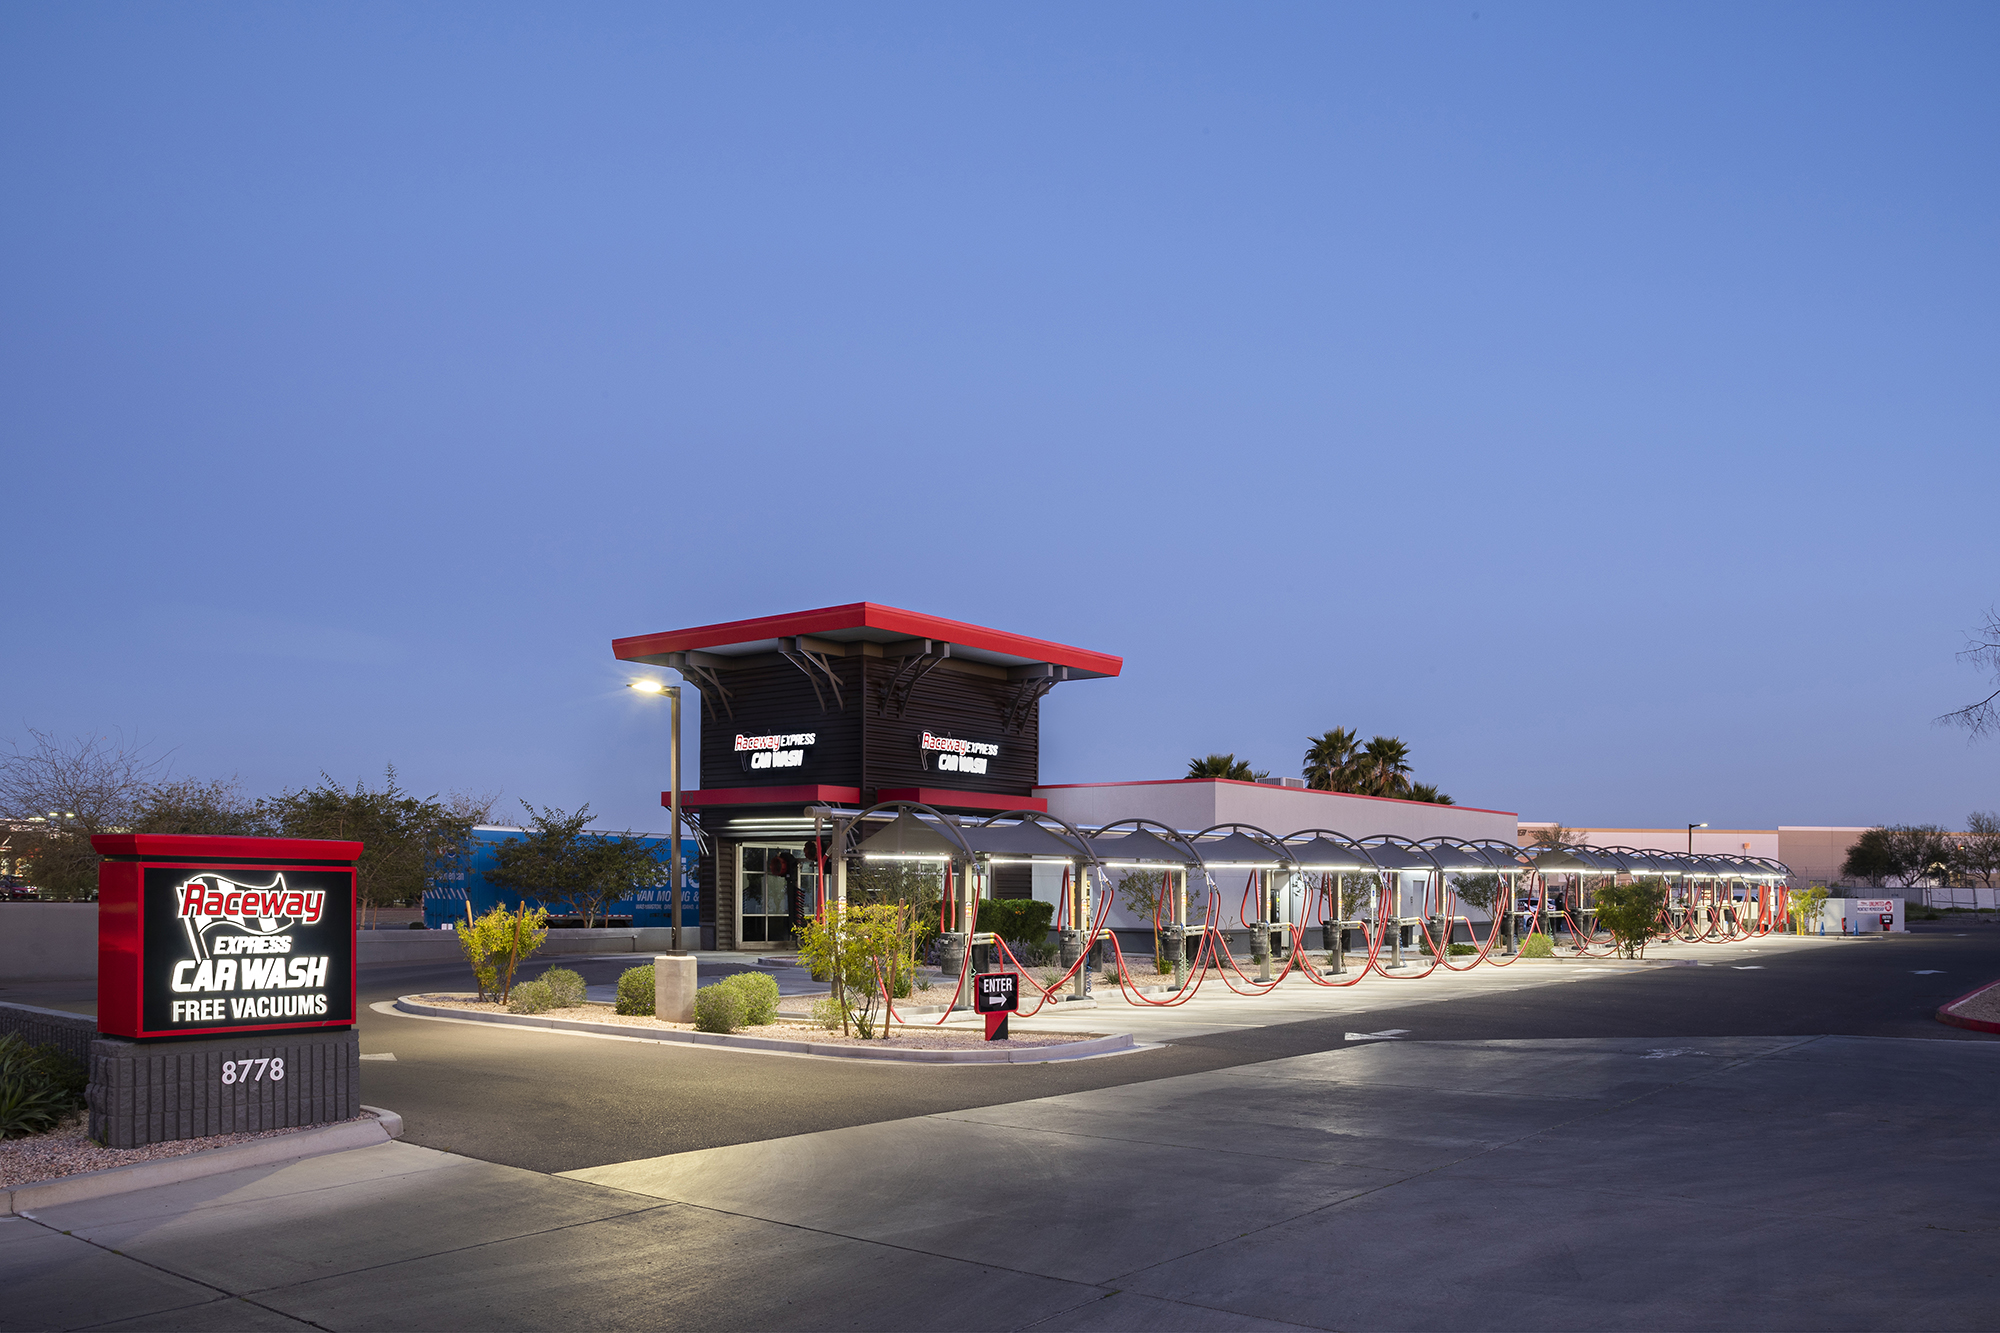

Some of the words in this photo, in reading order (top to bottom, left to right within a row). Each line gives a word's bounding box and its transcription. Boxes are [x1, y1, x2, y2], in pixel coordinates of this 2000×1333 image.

[735, 734, 780, 751] Raceway
[780, 733, 816, 747] EXPRESS
[922, 732, 967, 756] Raceway
[966, 742, 998, 756] EXPRESS
[751, 752, 772, 769] CAR
[772, 750, 804, 767] WASH
[938, 754, 959, 771] CAR
[959, 756, 988, 774] WASH
[178, 882, 326, 924] Raceway
[637, 891, 654, 902] VAN
[657, 890, 691, 902] MONG
[214, 936, 292, 954] EXPRESS
[171, 959, 238, 993] CAR
[241, 957, 328, 990] WASH
[984, 978, 1012, 992] ENTER
[172, 999, 226, 1022] FREE
[230, 994, 327, 1018] VACUUMS
[221, 1057, 285, 1085] 8778
